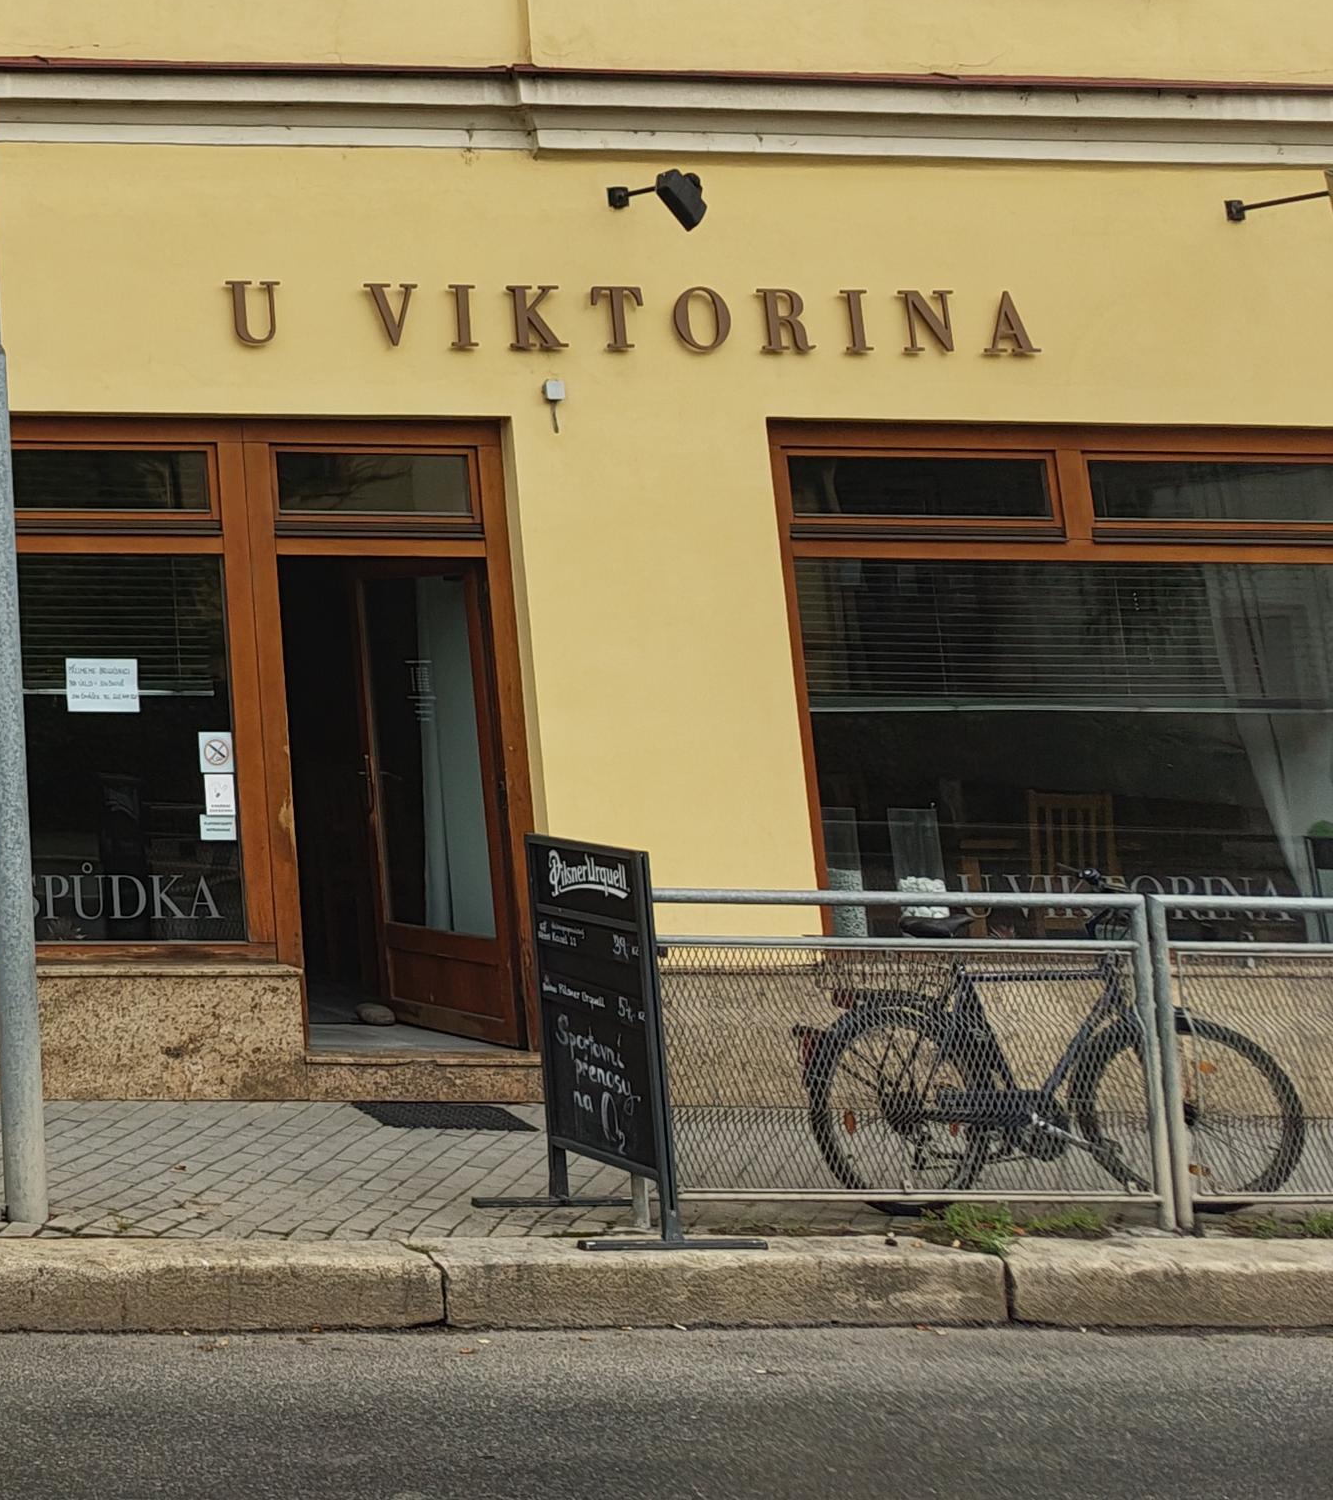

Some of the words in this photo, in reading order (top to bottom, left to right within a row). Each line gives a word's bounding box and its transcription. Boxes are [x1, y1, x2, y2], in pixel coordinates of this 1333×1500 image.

[224, 280, 280, 348] U
[363, 283, 1043, 355] VIKTORINA
[548, 849, 587, 897] Pilsner
[584, 853, 627, 897] Urquell
[555, 1013, 626, 1069] Sportovní
[573, 1053, 642, 1116] přenosy
[573, 1090, 594, 1113] na
